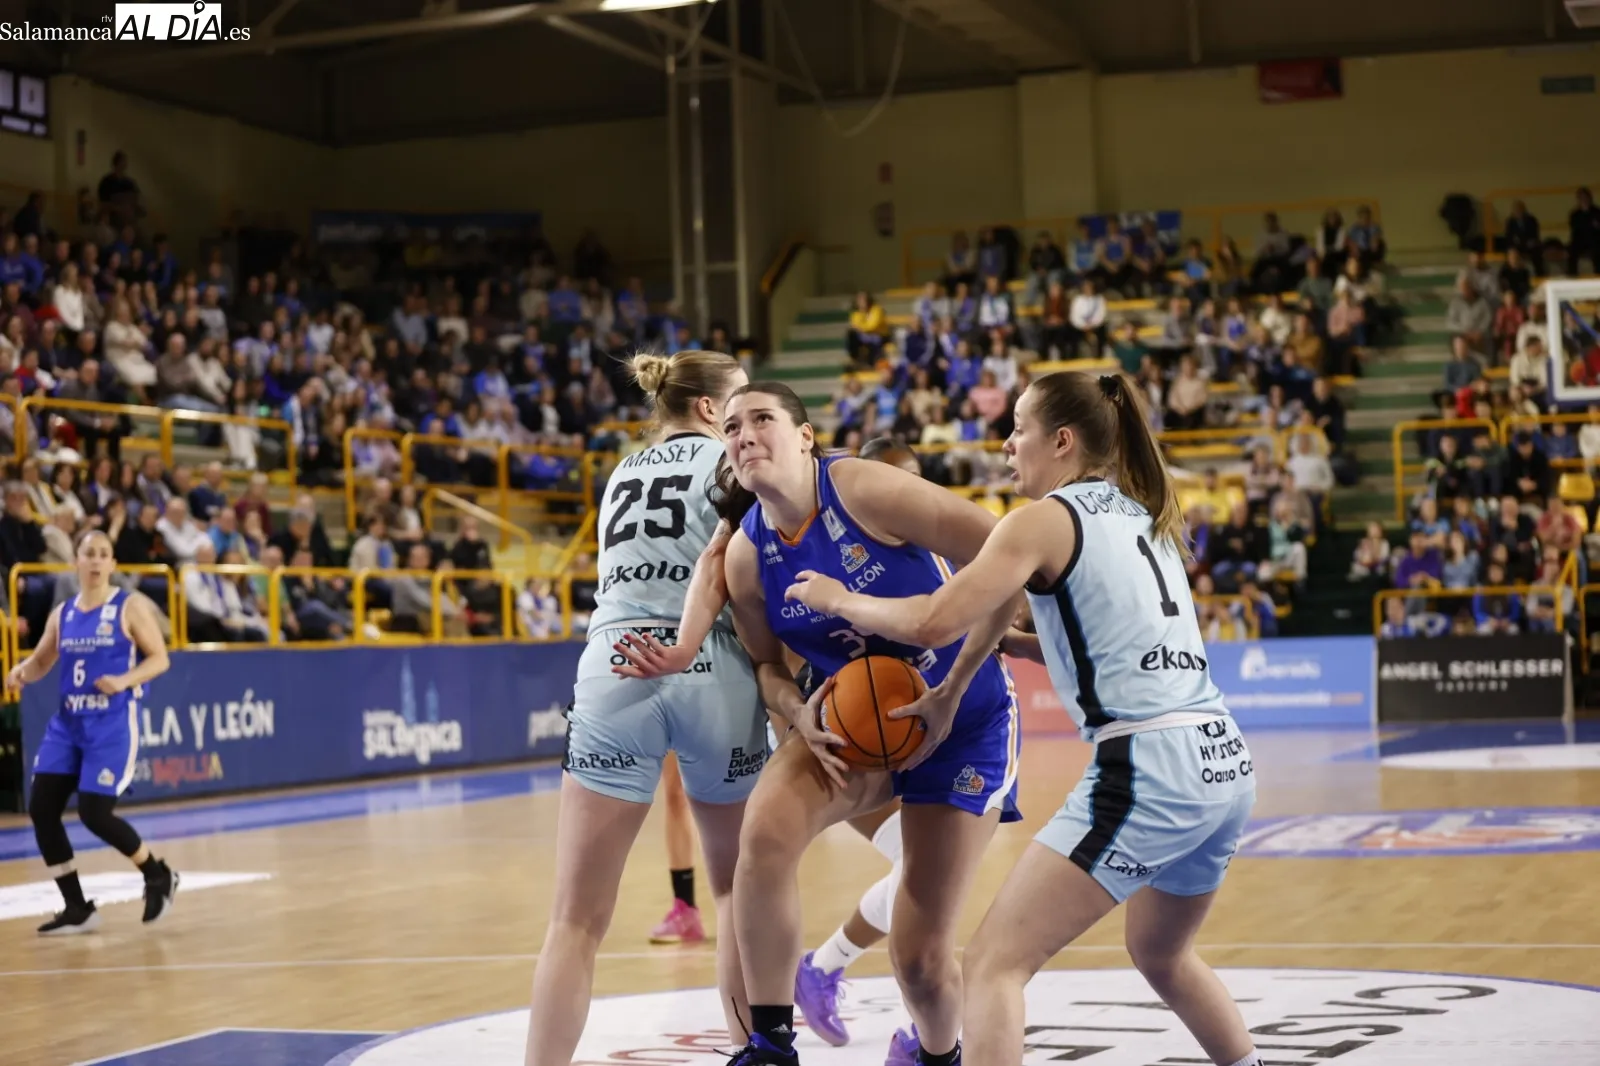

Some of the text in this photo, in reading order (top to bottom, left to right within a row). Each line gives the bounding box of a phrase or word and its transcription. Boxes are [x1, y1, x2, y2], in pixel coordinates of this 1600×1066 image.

[623, 443, 704, 469] MASSEY
[604, 474, 694, 553] 25
[848, 562, 886, 593] LEÓN
[1136, 534, 1180, 617] 1
[73, 659, 86, 688] 6
[1380, 658, 1564, 682] ANGEL SCHLESSER
[189, 703, 208, 751] Y
[213, 688, 275, 741] LEÓN
[729, 749, 765, 769] DIARIO
[731, 746, 746, 758] EL
[727, 760, 763, 779] VASCO
